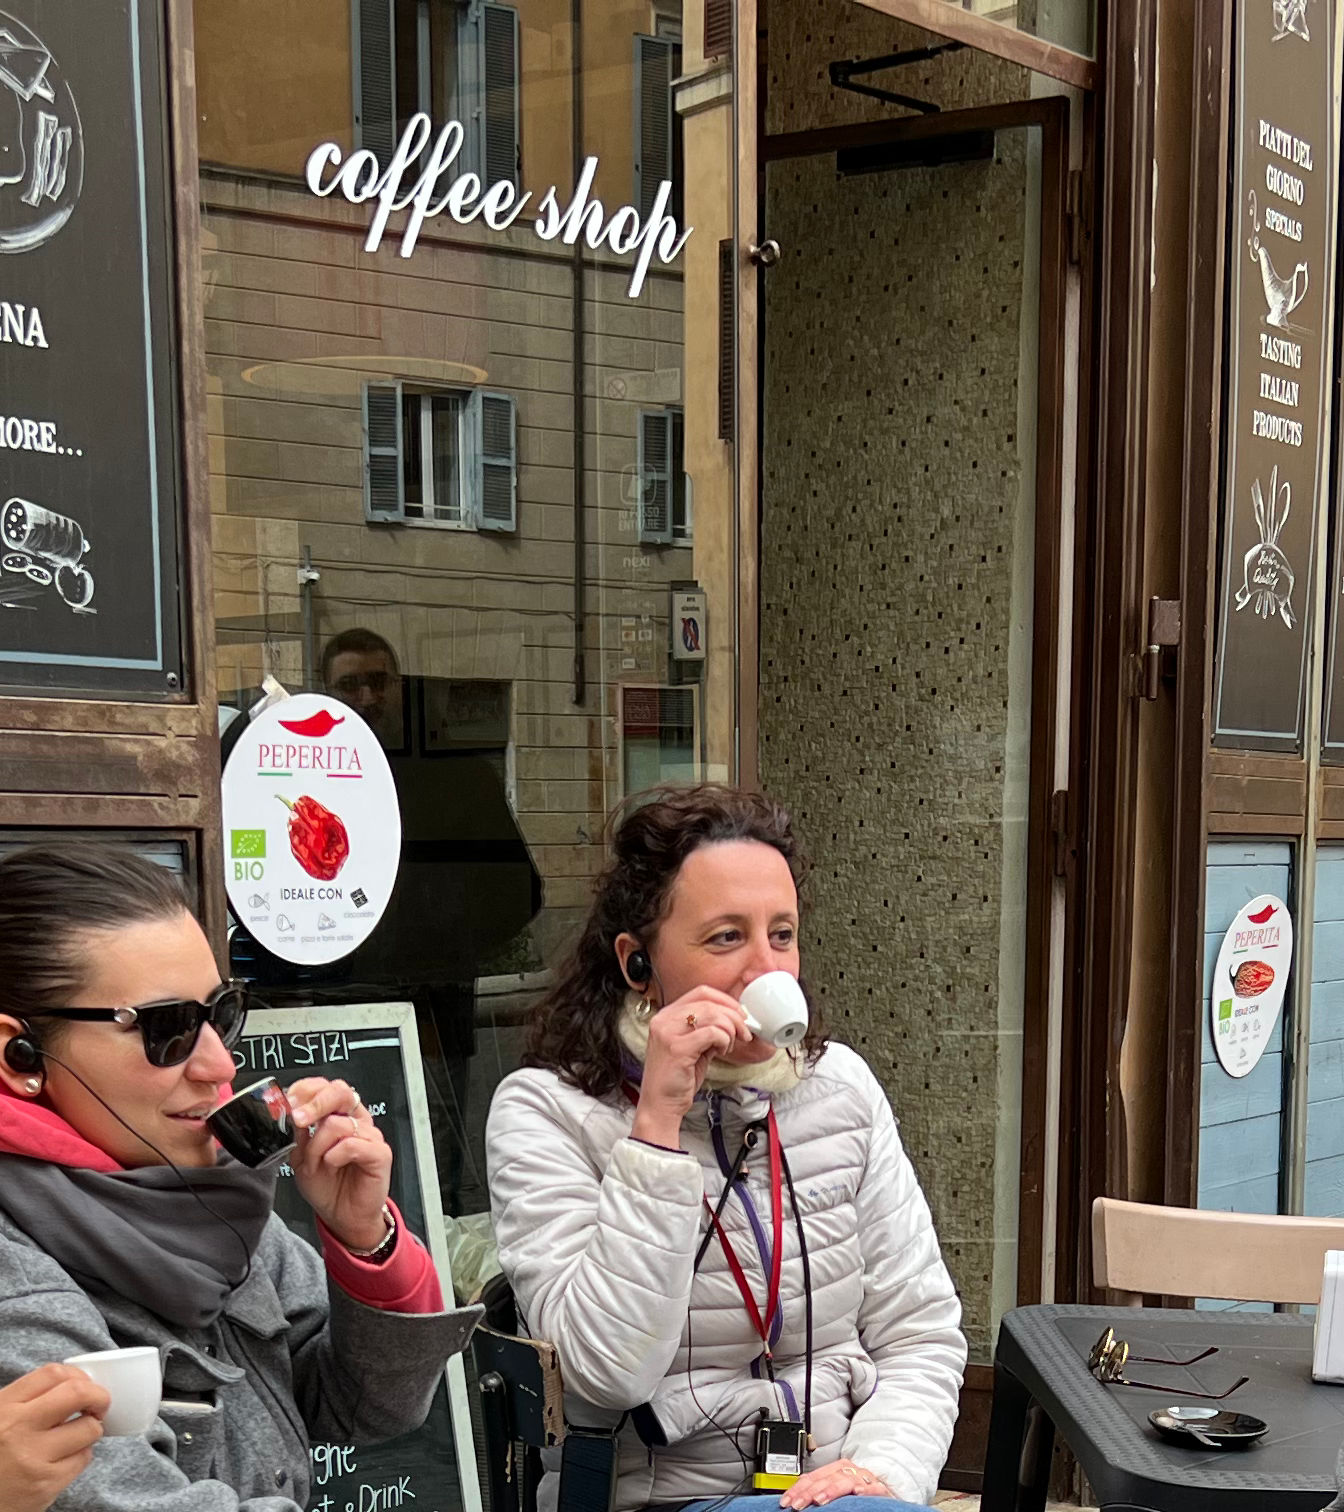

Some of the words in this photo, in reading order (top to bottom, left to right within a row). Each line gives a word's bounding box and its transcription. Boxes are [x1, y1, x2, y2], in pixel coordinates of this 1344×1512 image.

[1259, 119, 1292, 160] PIATTI
[1292, 136, 1313, 171] DEL
[1266, 164, 1304, 206] GIORNO
[306, 112, 532, 258] coffee
[535, 156, 694, 298] shop
[1265, 207, 1302, 242] SPECIALS
[1260, 333, 1302, 369] TASTING
[1259, 372, 1299, 407] ITALIAN
[1252, 410, 1303, 448] PRODUCTS
[258, 743, 362, 770] PEPERITA
[234, 860, 264, 881] BIO
[280, 888, 315, 900] IDEALE
[318, 888, 343, 900] CON
[1234, 926, 1281, 949] PEPERITA
[1219, 1020, 1231, 1036] BIO
[290, 1032, 349, 1065] SFIZI
